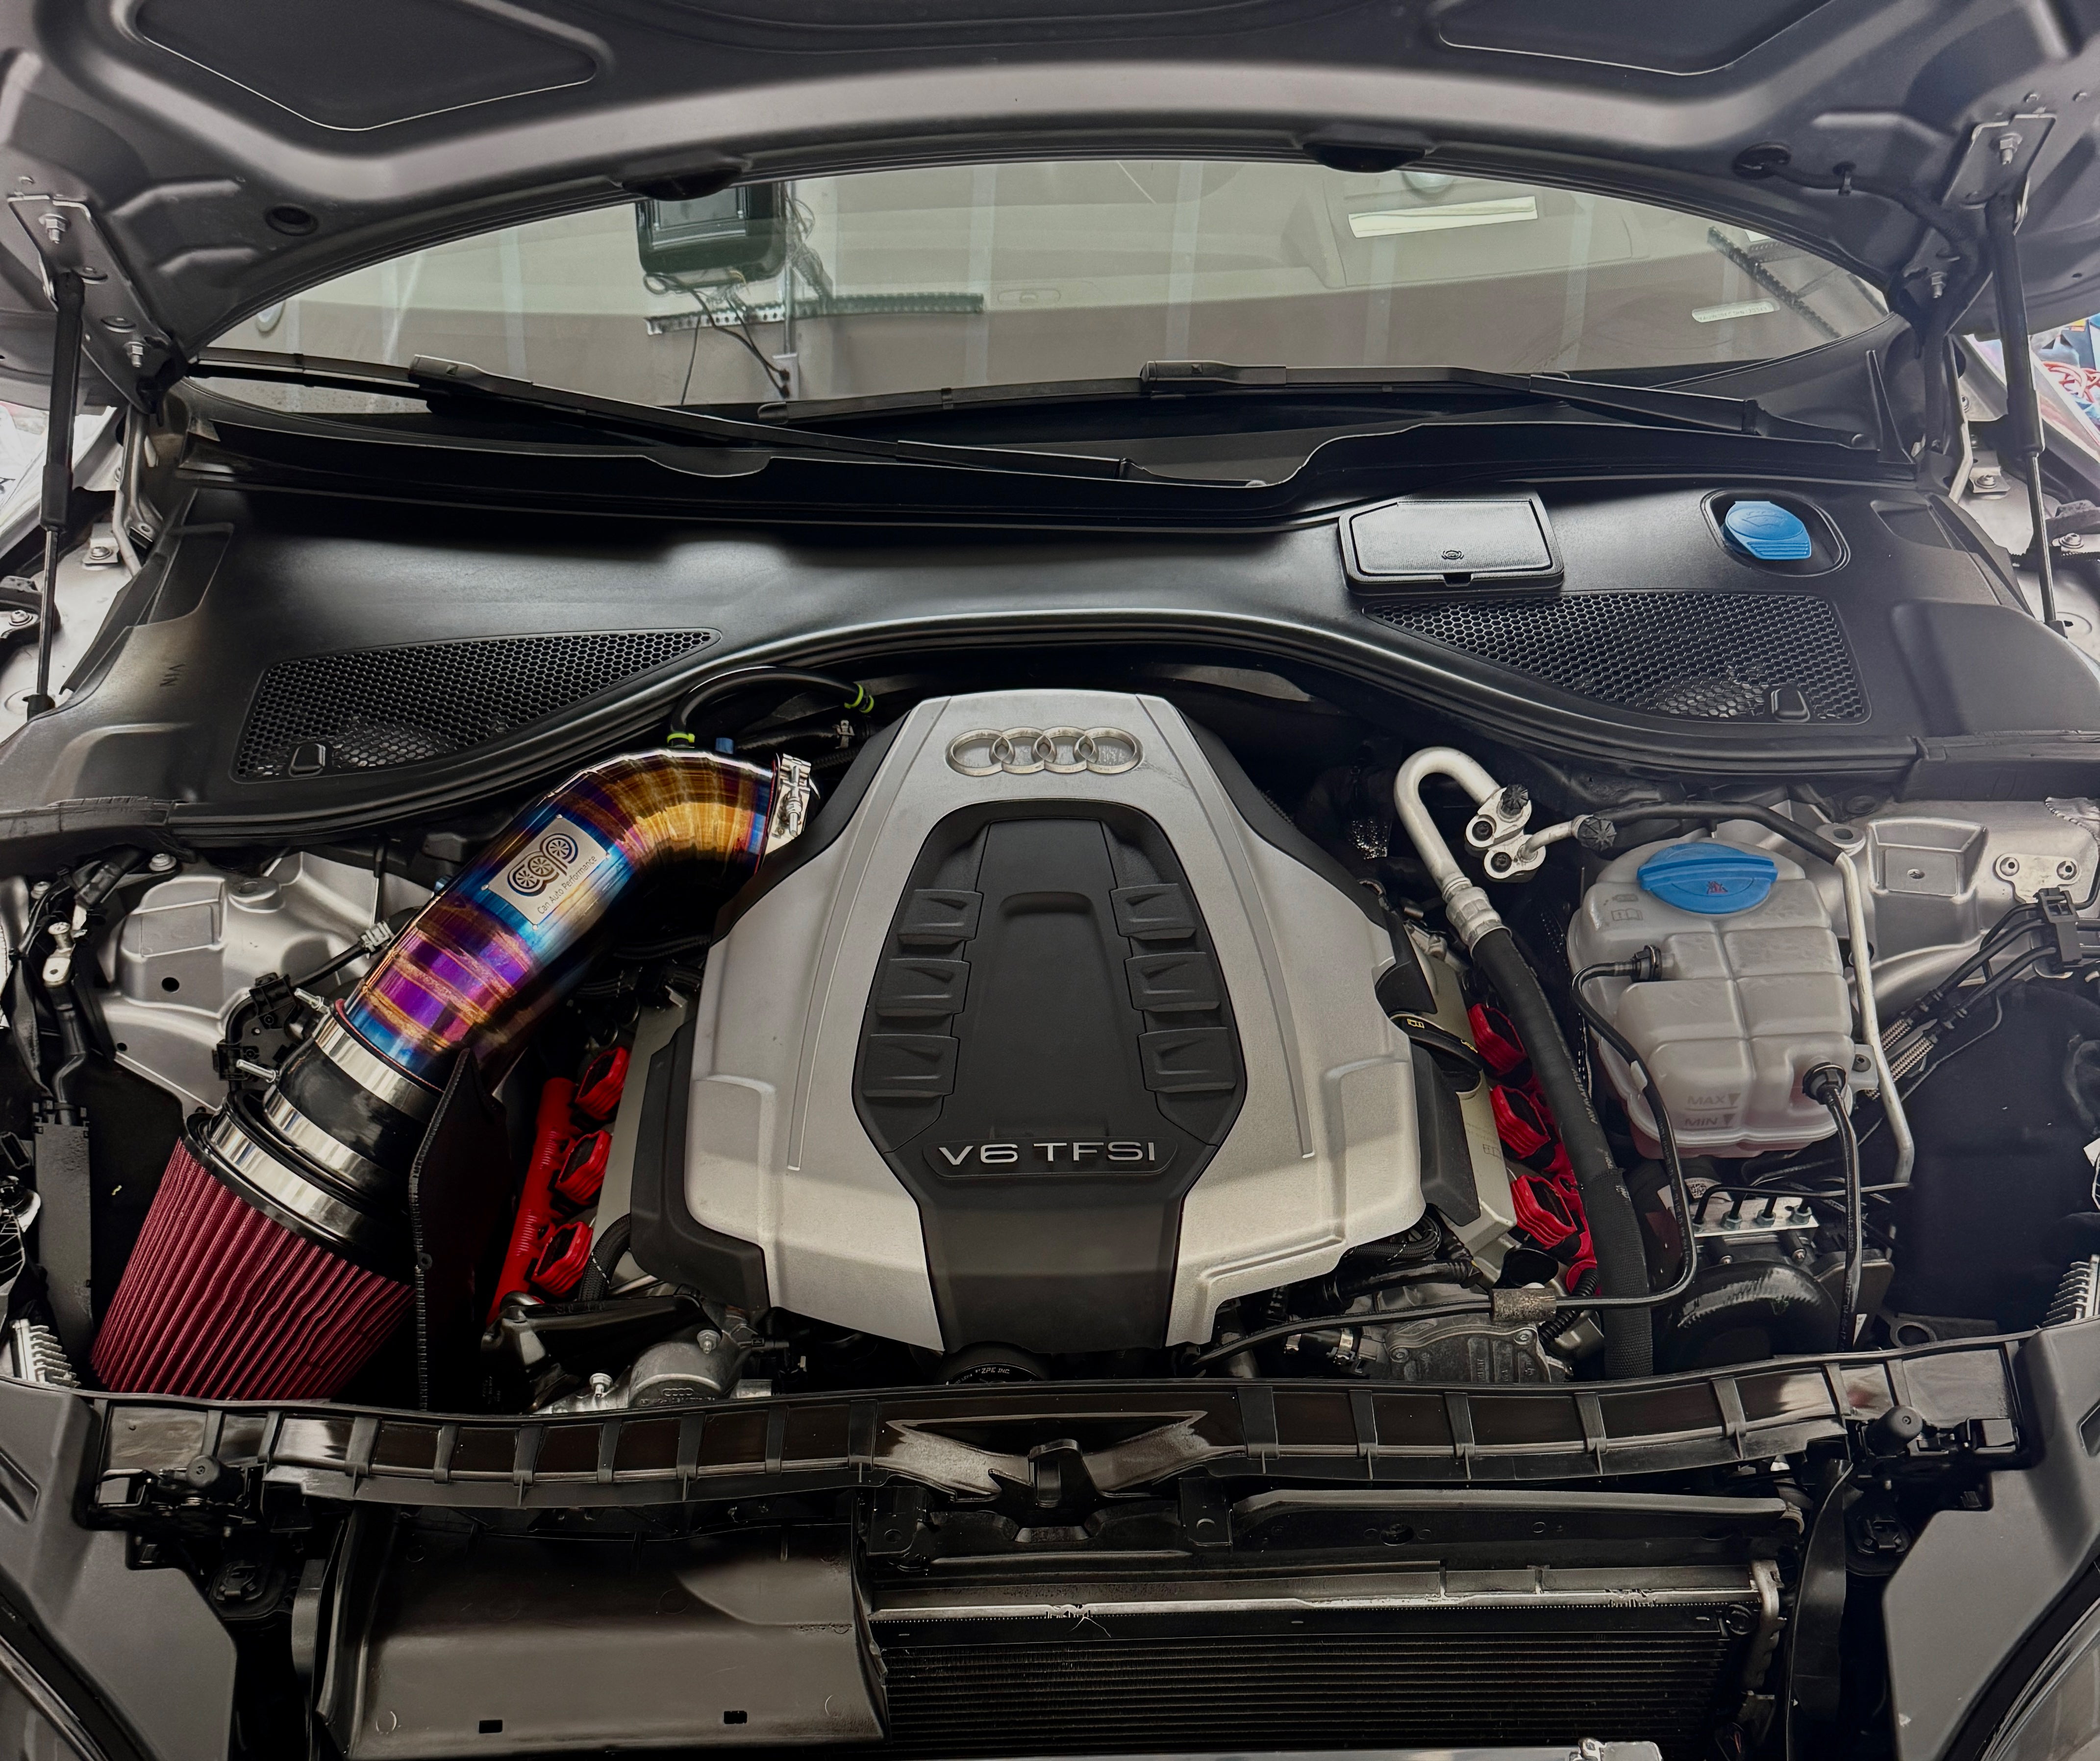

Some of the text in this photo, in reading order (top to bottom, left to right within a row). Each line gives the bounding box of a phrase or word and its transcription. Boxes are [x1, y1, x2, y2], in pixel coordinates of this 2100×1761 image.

[537, 855, 598, 915] Can Auto Performance
[1687, 1094, 1725, 1105] MAX
[1685, 1117, 1718, 1127] MIN
[939, 1141, 1155, 1165] V6 TFSI
